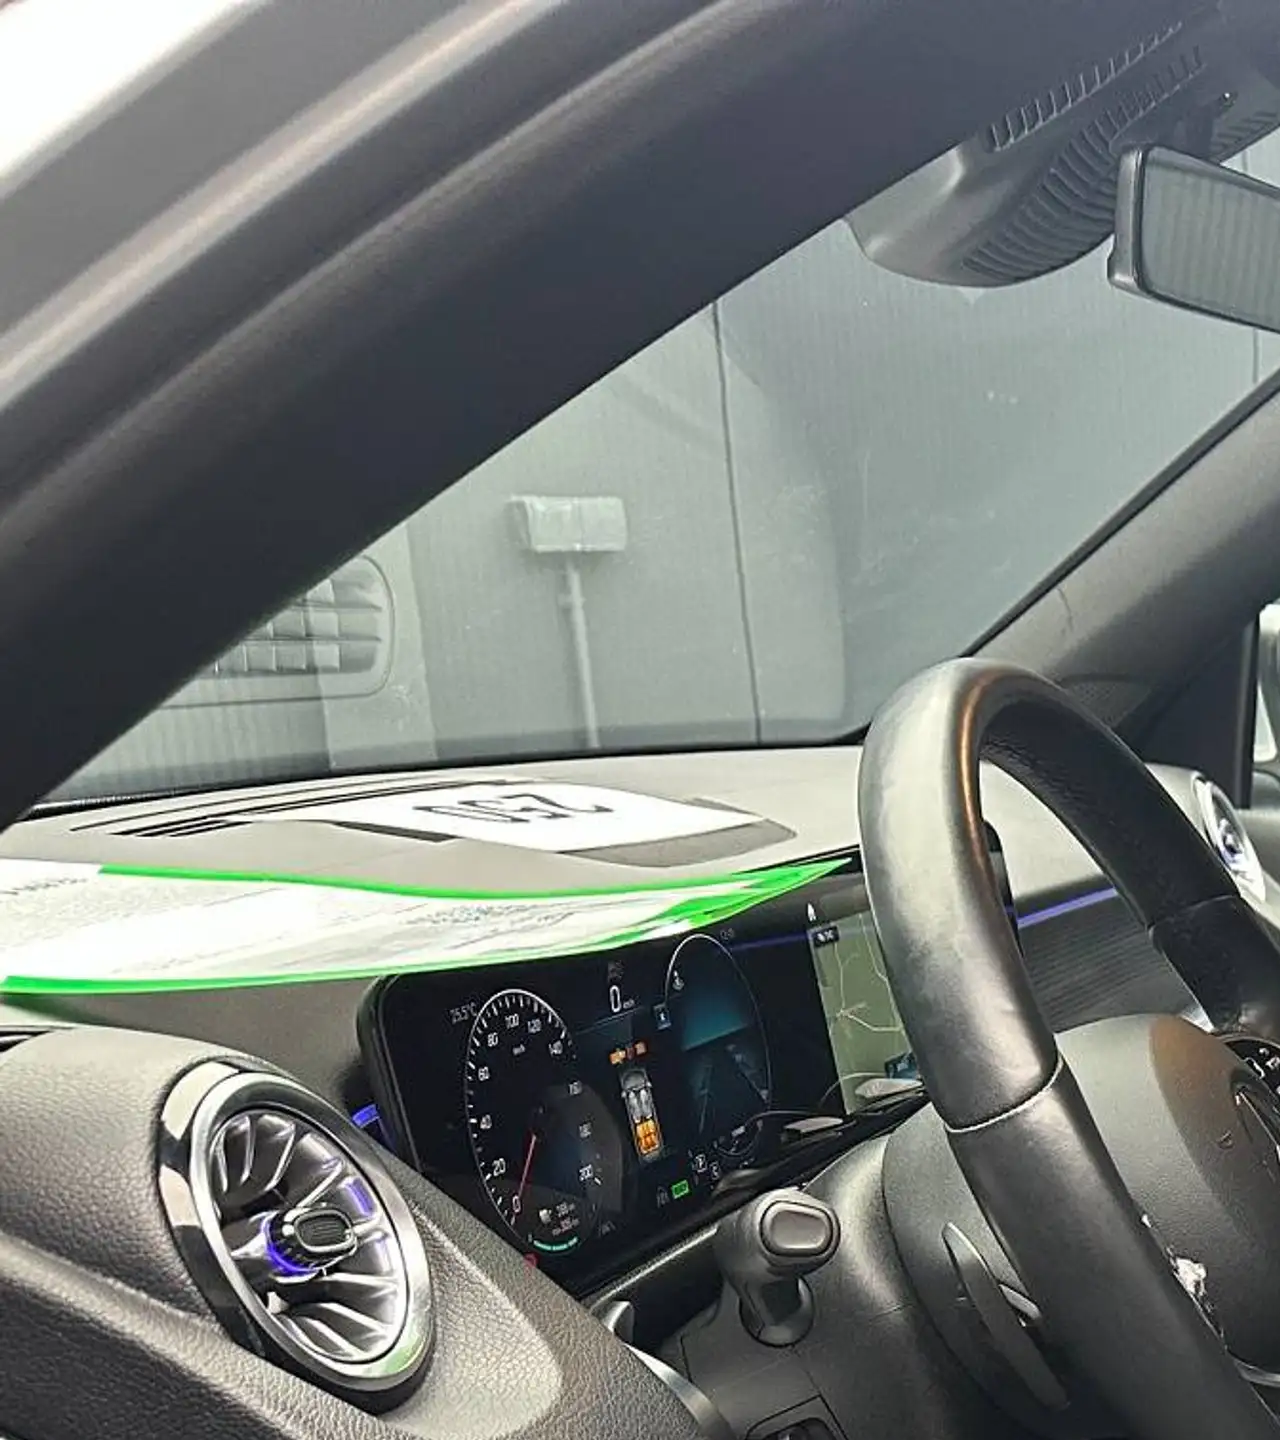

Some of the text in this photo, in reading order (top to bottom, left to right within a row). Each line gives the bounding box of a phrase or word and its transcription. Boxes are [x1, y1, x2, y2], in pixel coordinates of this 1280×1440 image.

[505, 1014, 520, 1029] 100
[527, 1019, 542, 1034] 120
[487, 1032, 499, 1047] 80
[478, 1066, 490, 1081] 60
[492, 1158, 506, 1176] 20
[512, 1195, 522, 1213] 0
